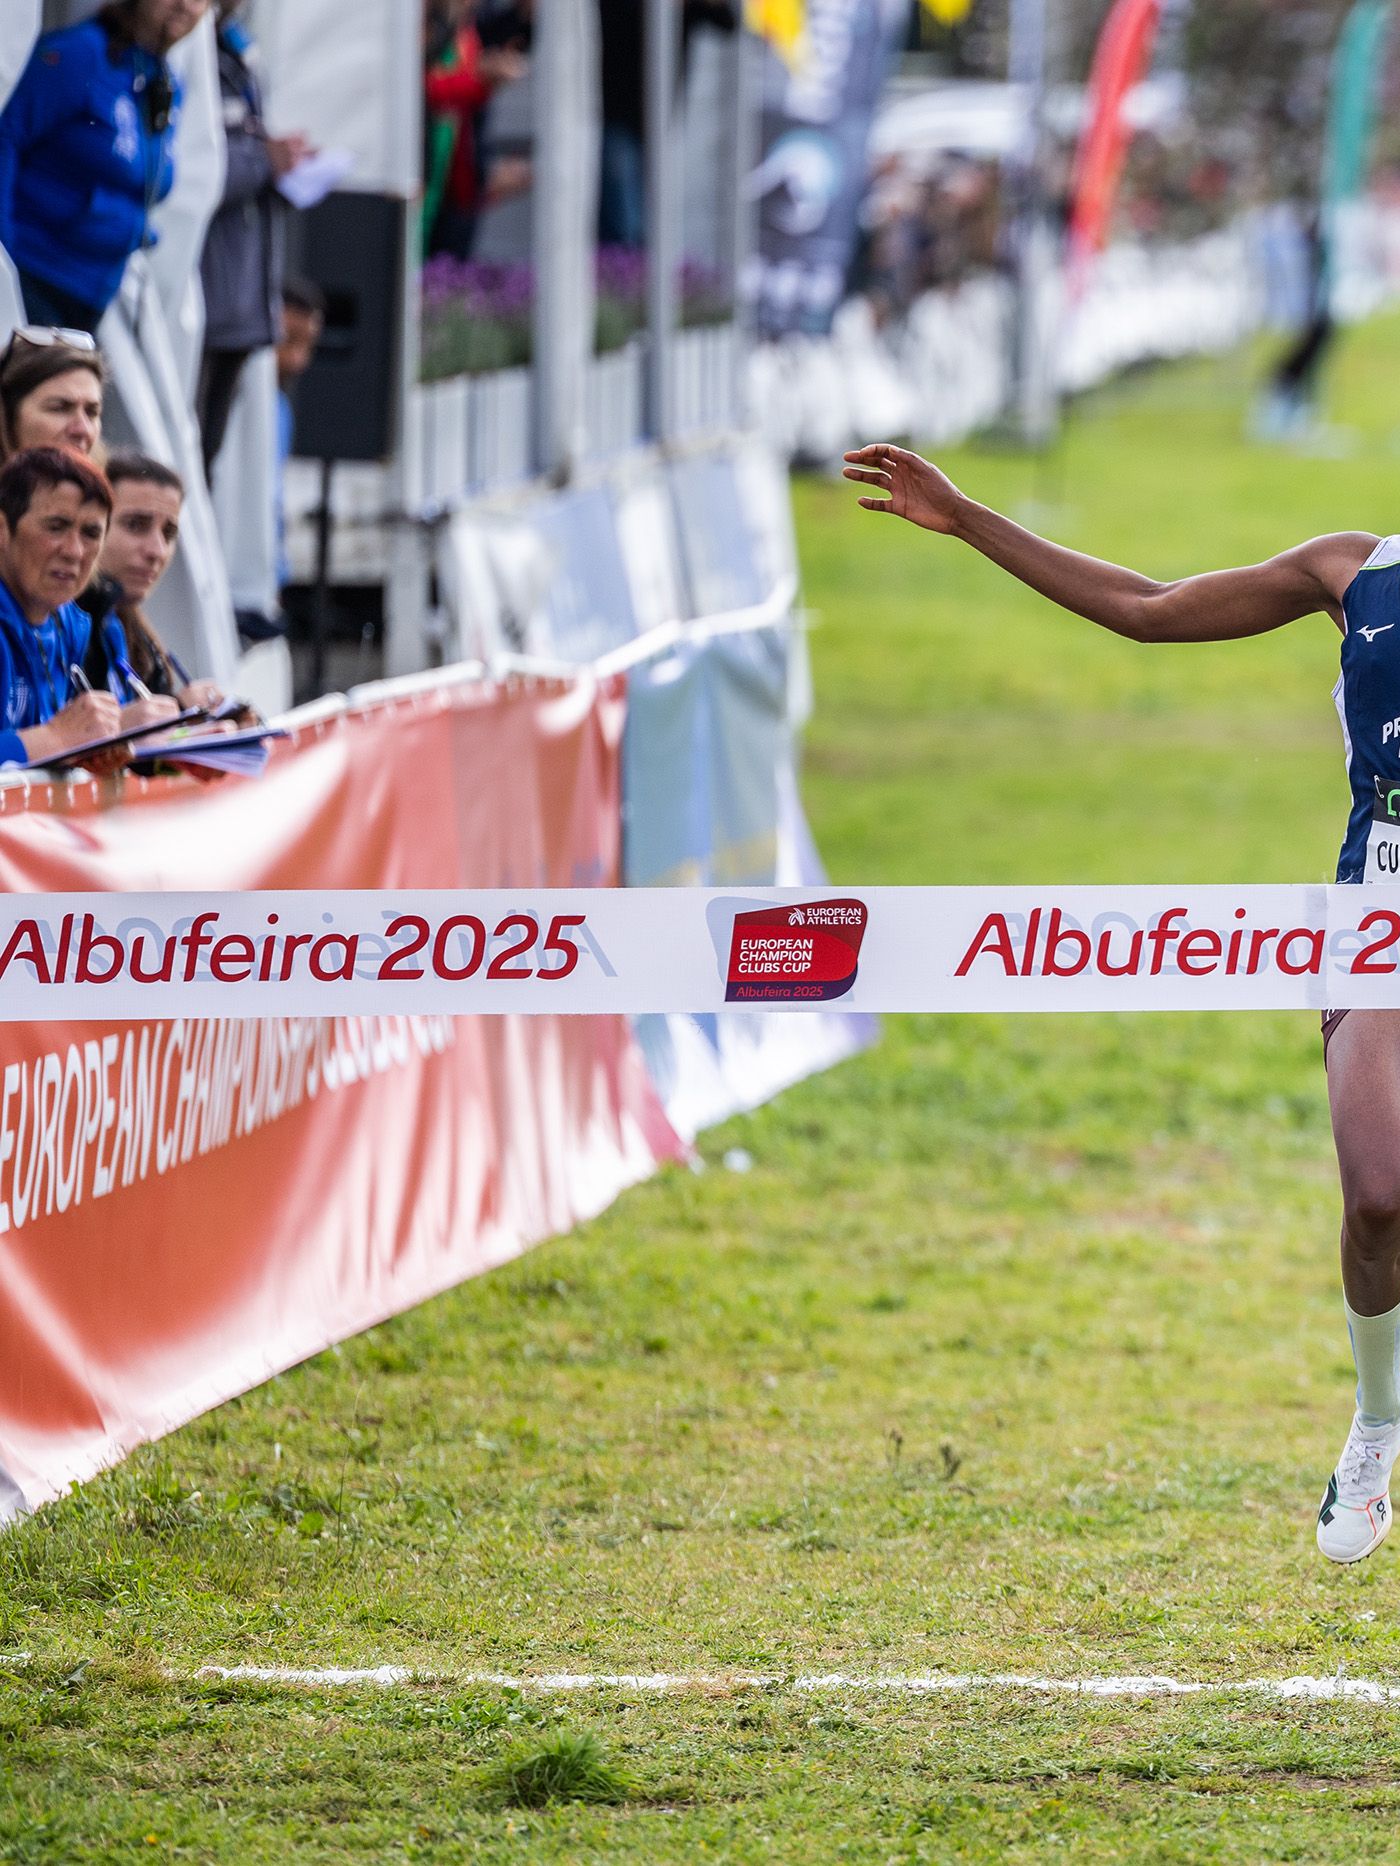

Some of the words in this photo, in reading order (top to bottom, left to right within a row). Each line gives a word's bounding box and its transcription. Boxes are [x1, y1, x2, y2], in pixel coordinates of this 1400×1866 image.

[806, 908, 862, 917] EUROPEAN
[806, 917, 862, 926] ATHLETICS
[741, 939, 813, 950] EUROPEAN
[955, 908, 1326, 977] Albufeira
[0, 913, 360, 985] Albufeira
[377, 914, 586, 981] 2025
[740, 951, 813, 962] CHAMPION
[738, 963, 780, 974] CLUBS
[783, 963, 811, 973] CUP
[736, 986, 791, 998] Albufeira
[794, 986, 824, 997] 2025
[0, 1022, 164, 1233] EUROPEAN
